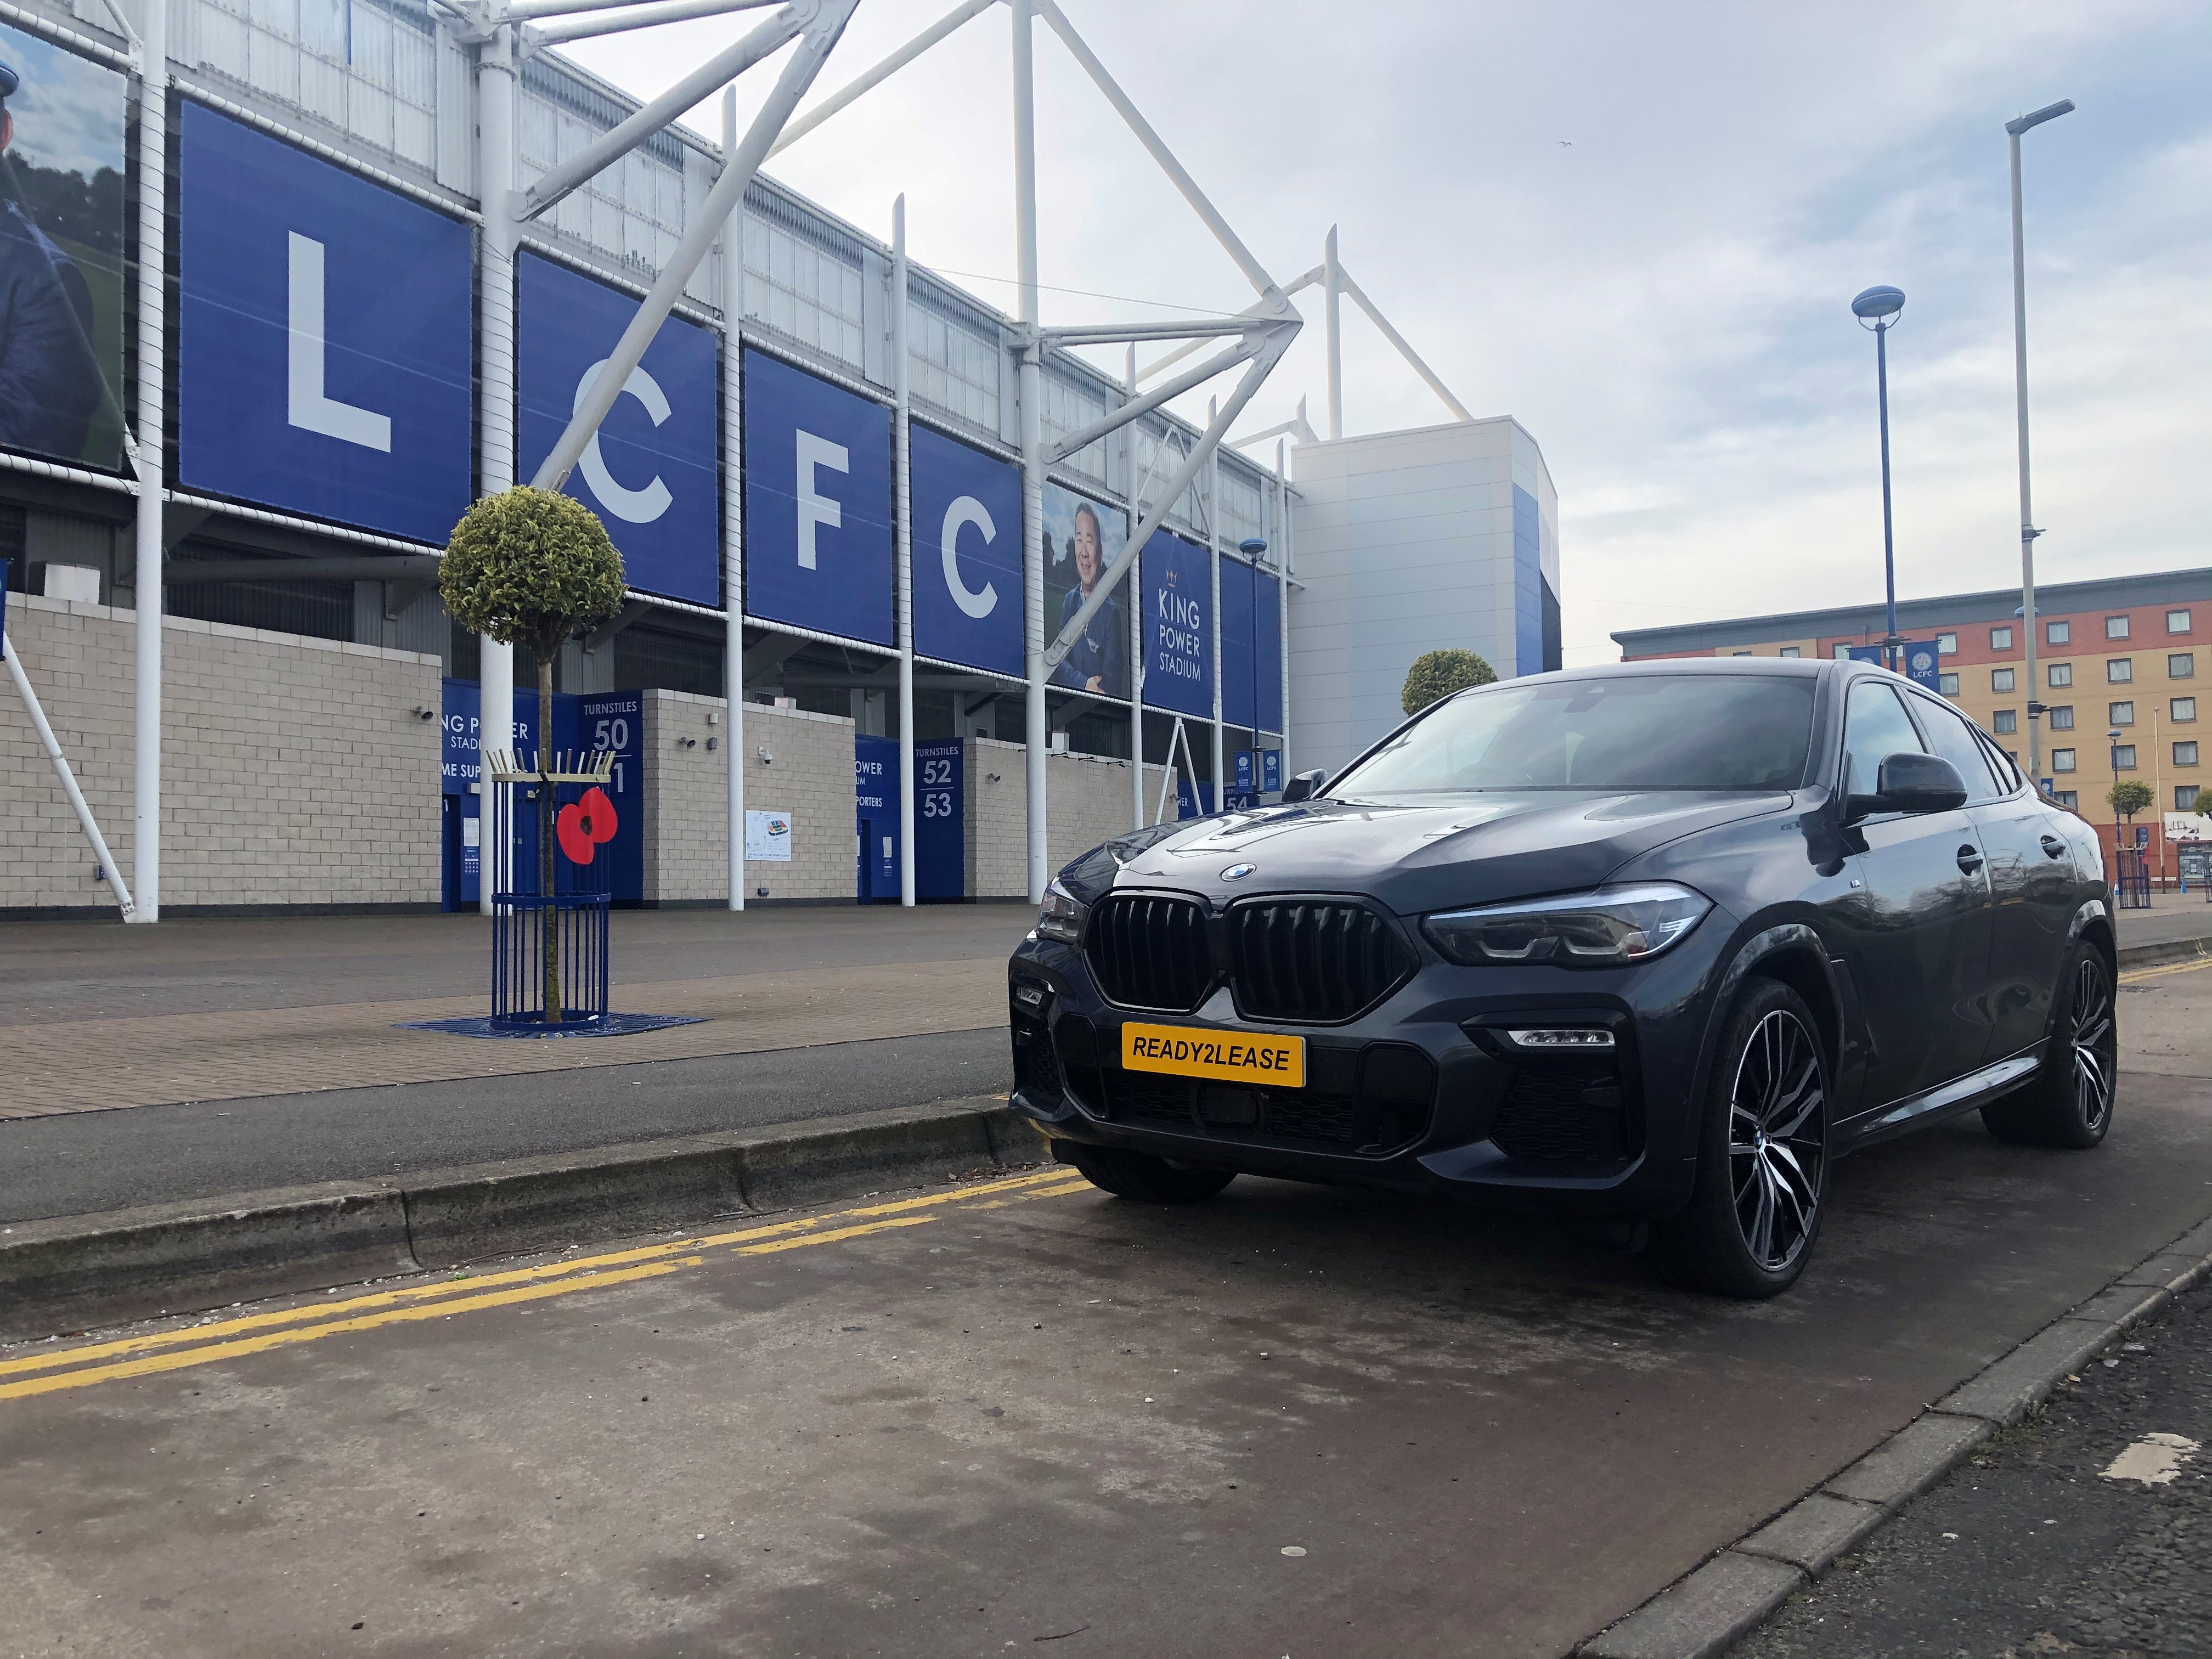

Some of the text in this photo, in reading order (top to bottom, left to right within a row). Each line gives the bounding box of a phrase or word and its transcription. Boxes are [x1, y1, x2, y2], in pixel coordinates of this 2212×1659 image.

[289, 230, 391, 453] L
[796, 428, 849, 570] F
[941, 495, 998, 618] C
[1159, 588, 1200, 629] KING
[1159, 624, 1200, 657] POWER
[1159, 652, 1201, 681] STADIUM
[584, 701, 637, 715] TURNSTILES
[470, 718, 528, 740] PER
[593, 718, 628, 751] 50
[916, 747, 958, 757] TURNSTILES
[923, 759, 951, 784] 52
[923, 793, 952, 817] 53
[1227, 796, 1247, 810] 54
[1132, 1036, 1290, 1071] READY2LEASE
